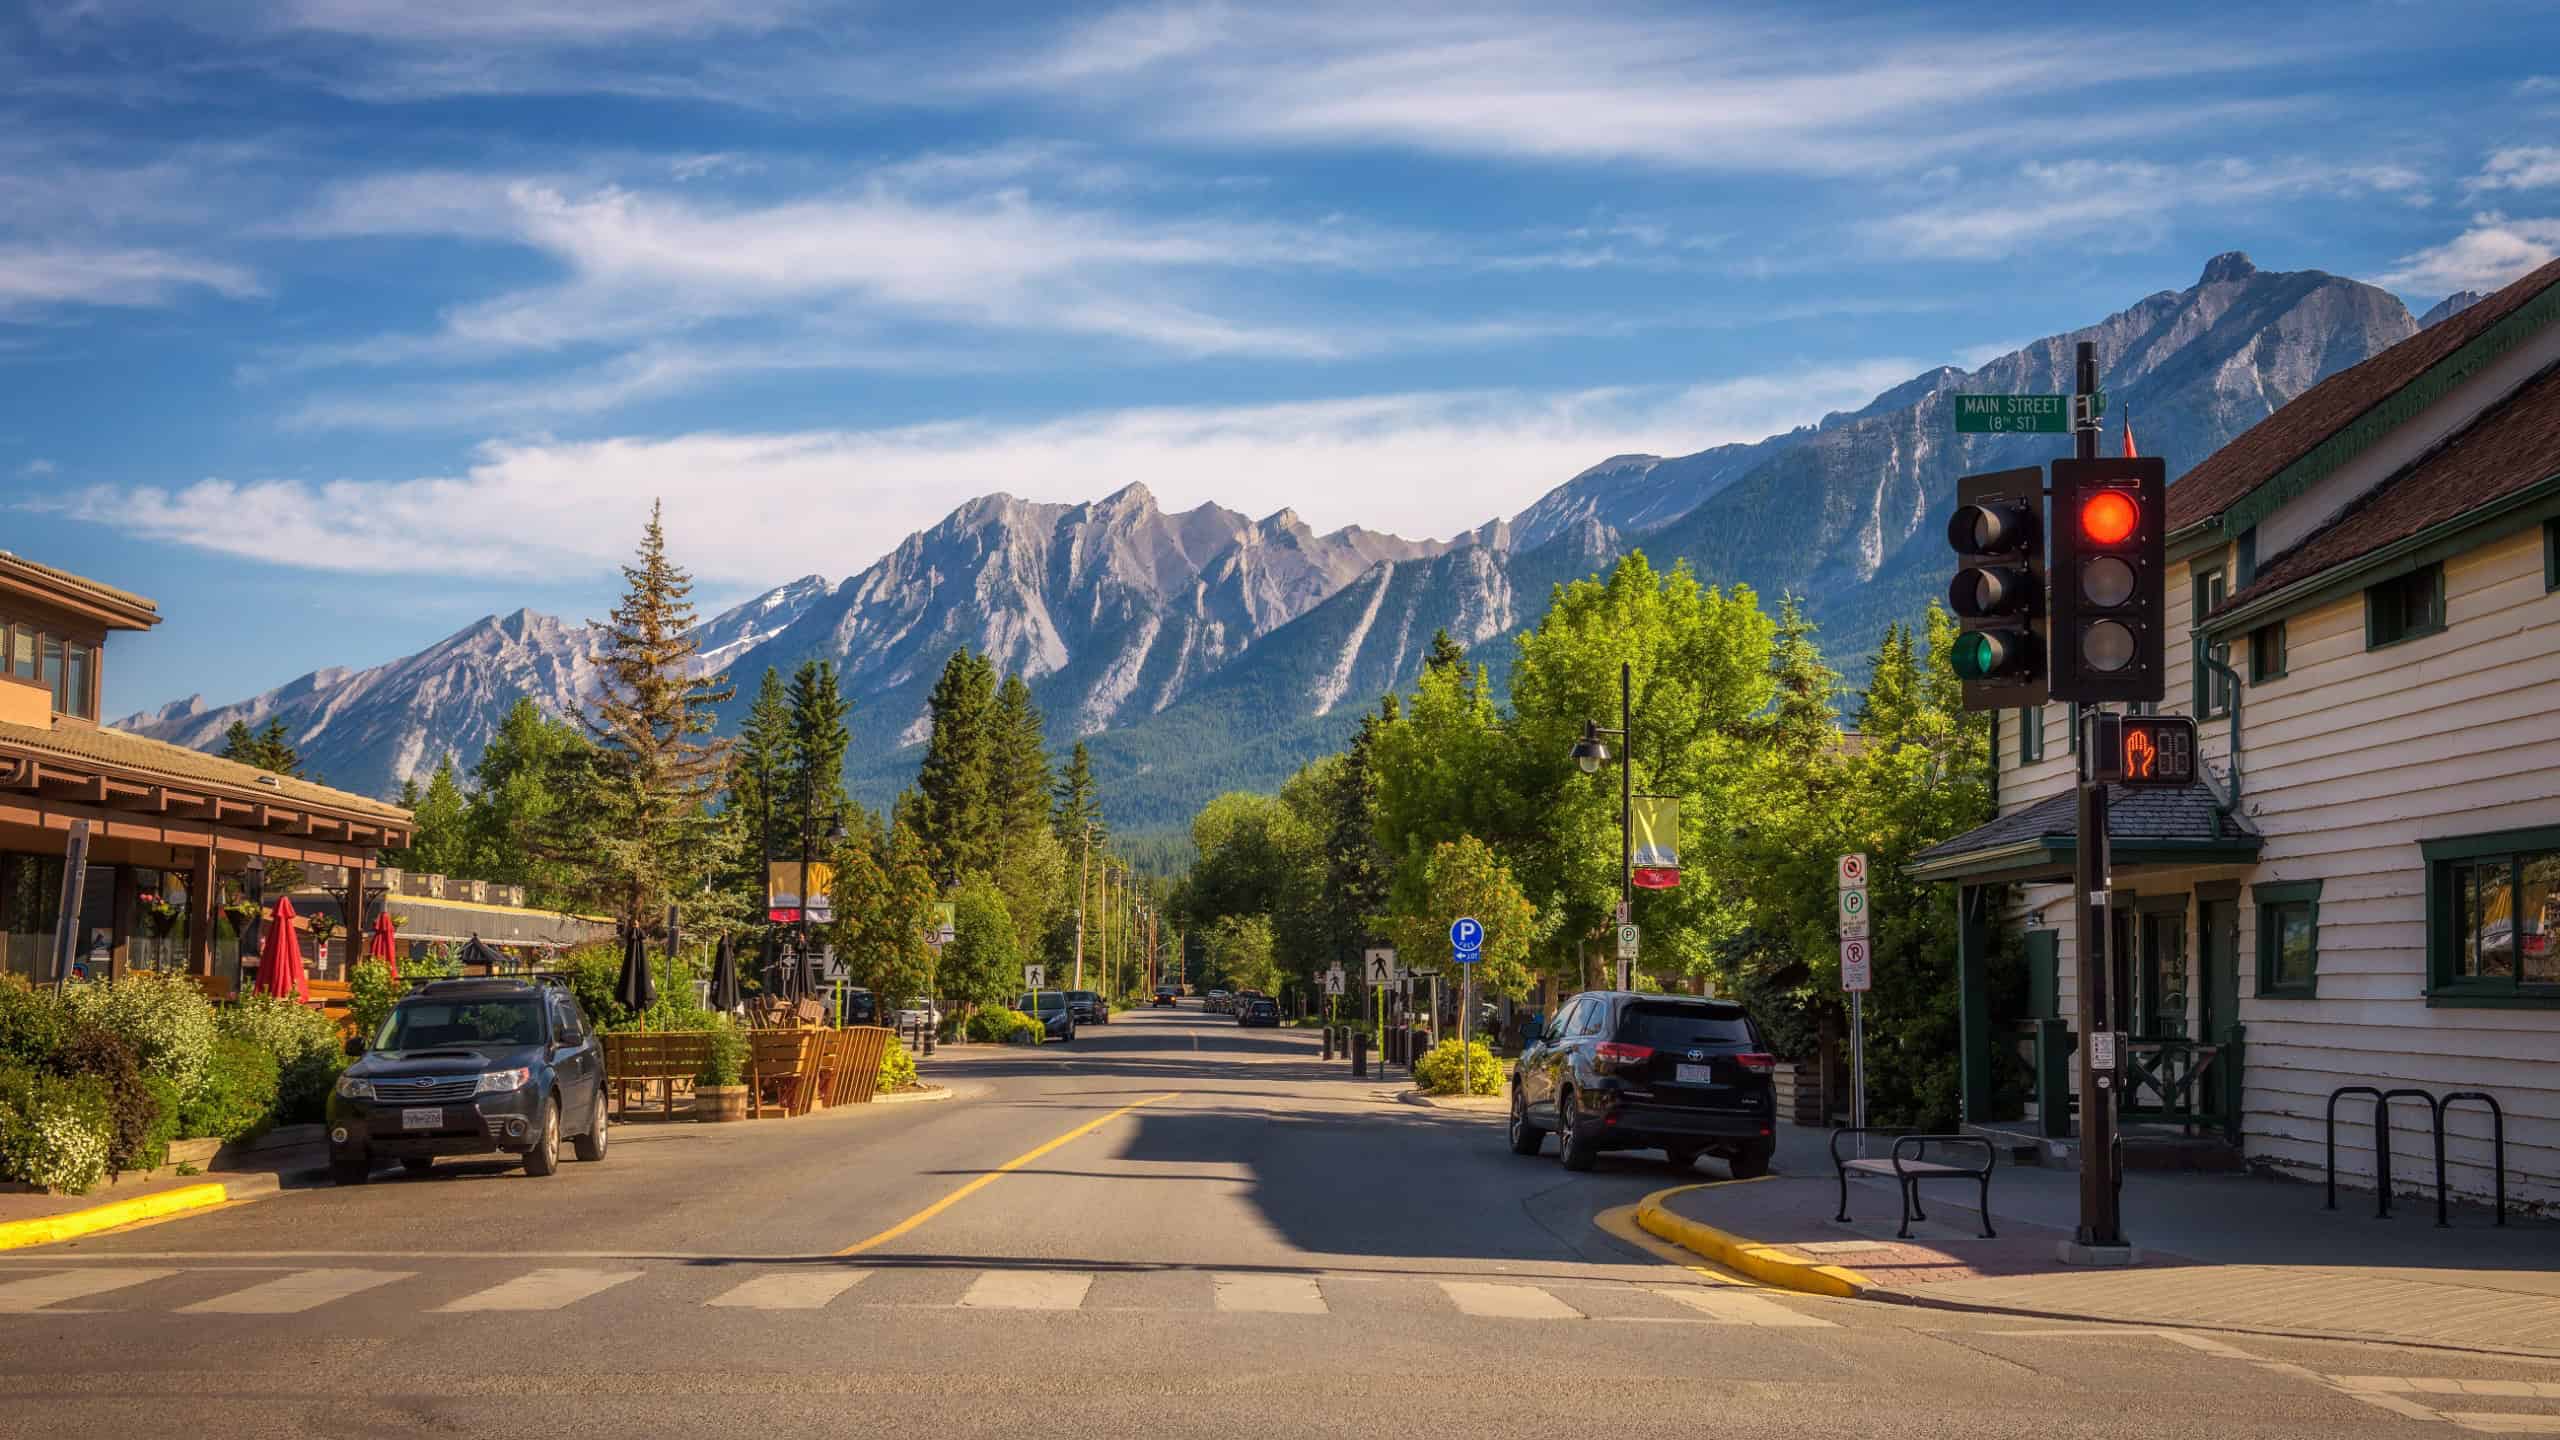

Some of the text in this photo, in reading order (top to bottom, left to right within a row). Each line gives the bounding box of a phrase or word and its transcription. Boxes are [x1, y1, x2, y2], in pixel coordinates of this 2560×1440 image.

[1964, 397, 2060, 414] MAIN STREET
[2016, 415, 2037, 431] ST)
[1461, 922, 1475, 941] P
